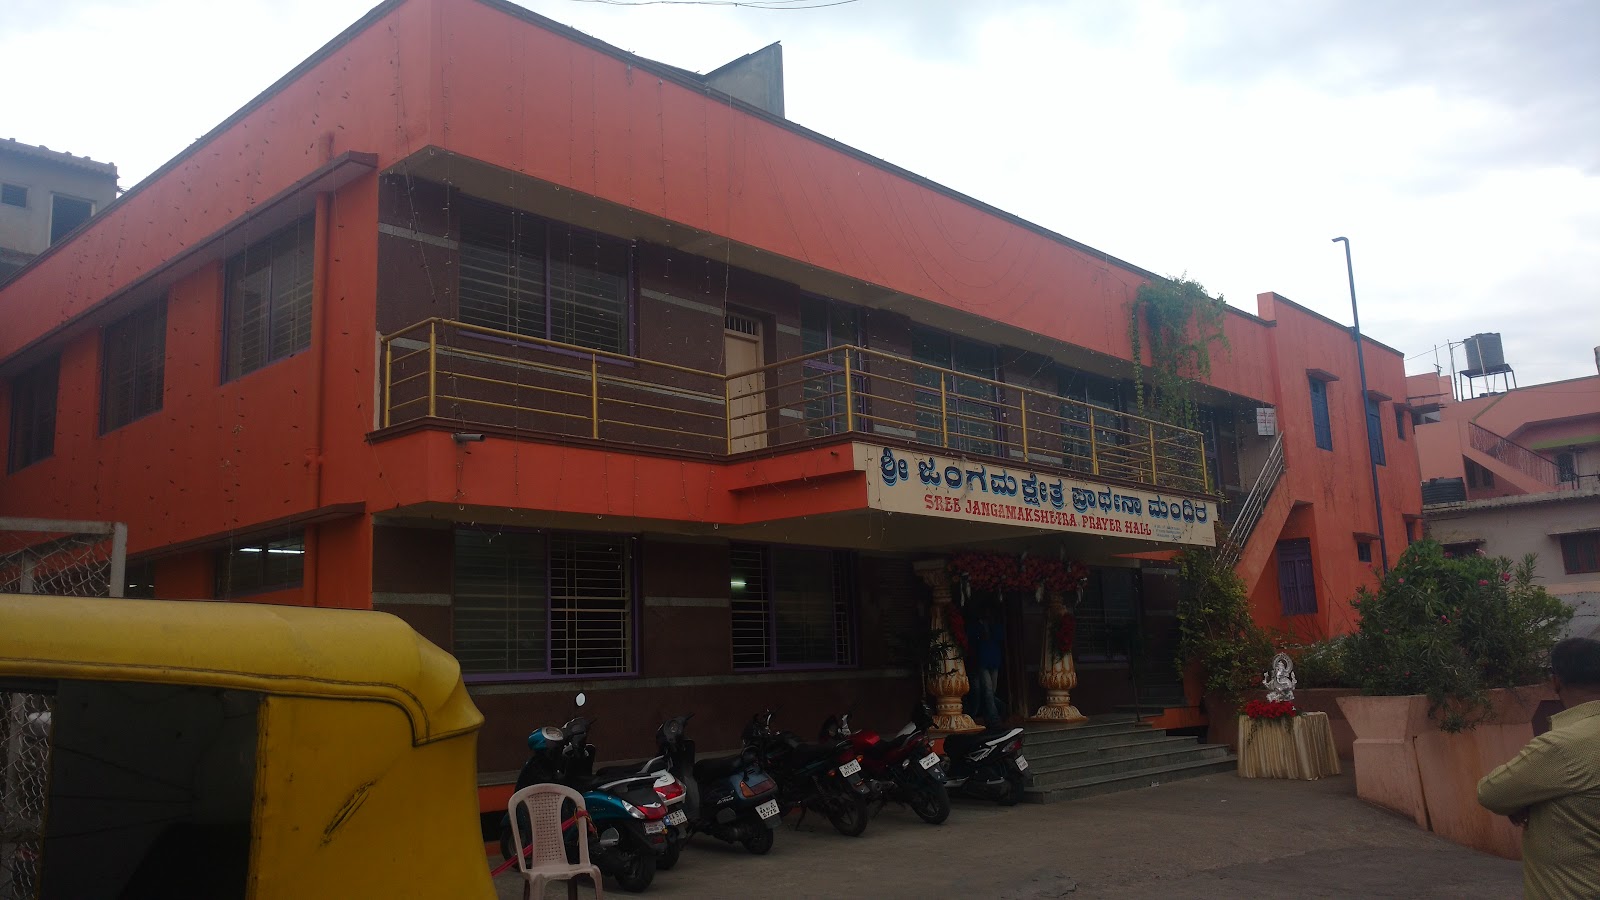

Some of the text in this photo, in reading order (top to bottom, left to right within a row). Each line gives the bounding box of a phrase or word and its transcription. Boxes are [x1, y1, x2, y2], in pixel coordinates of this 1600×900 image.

[881, 447, 909, 487] ಶ್ರೀ
[918, 457, 1065, 511] ಜಂಗಮಕ್ಷೇತ್ರ
[1148, 495, 1208, 524] ಮಂದಿರ
[924, 494, 962, 513] SREE
[965, 499, 1078, 528] JANGAMAKSHETRA
[1081, 514, 1123, 534] PRAYER
[1124, 521, 1152, 536] HALL
